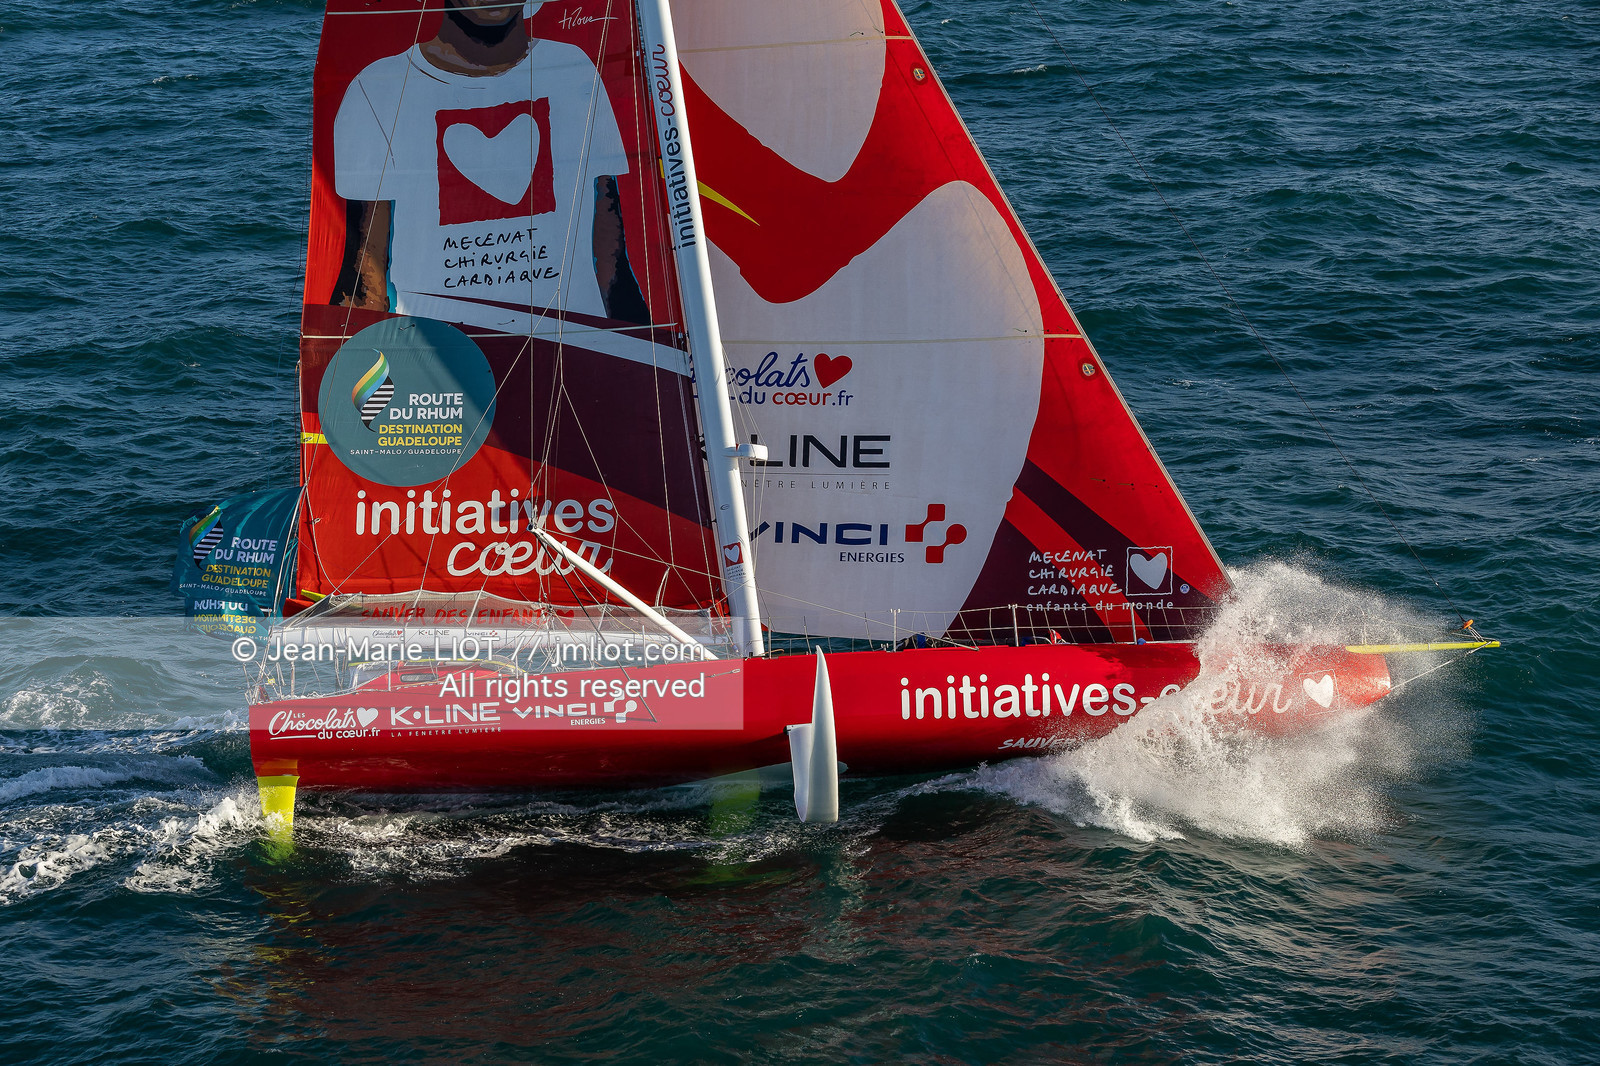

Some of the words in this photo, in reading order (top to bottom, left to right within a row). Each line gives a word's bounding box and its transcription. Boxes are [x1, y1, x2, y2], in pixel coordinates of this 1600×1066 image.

[443, 228, 538, 251] MECENAT
[725, 351, 811, 388] colats
[409, 393, 463, 405] ROUTE
[739, 386, 766, 404] du
[389, 408, 412, 420] DU
[417, 407, 463, 420] RHUM
[379, 424, 463, 434] DESTINATION
[378, 436, 462, 447] GUADELOUPE
[749, 434, 891, 468] LINE
[355, 489, 615, 535] initiatives
[231, 536, 278, 552] ROUTE
[215, 549, 233, 560] DU
[236, 552, 275, 565] RHUM
[839, 552, 905, 563] ENERGIES
[1028, 549, 1107, 564] MECENAT
[206, 564, 271, 578] DESTINATION
[202, 573, 269, 589] GUADELOUPE
[1026, 600, 1087, 612] enfants
[1095, 600, 1113, 611] du
[1122, 598, 1174, 611] monde
[360, 603, 427, 625] SAUVER
[433, 608, 469, 625] DES
[900, 671, 1294, 722] initiatives-cur
[512, 702, 596, 720] VINCI
[268, 707, 357, 736] Chocolats
[570, 717, 606, 726] ENERGIES
[318, 729, 333, 740] du
